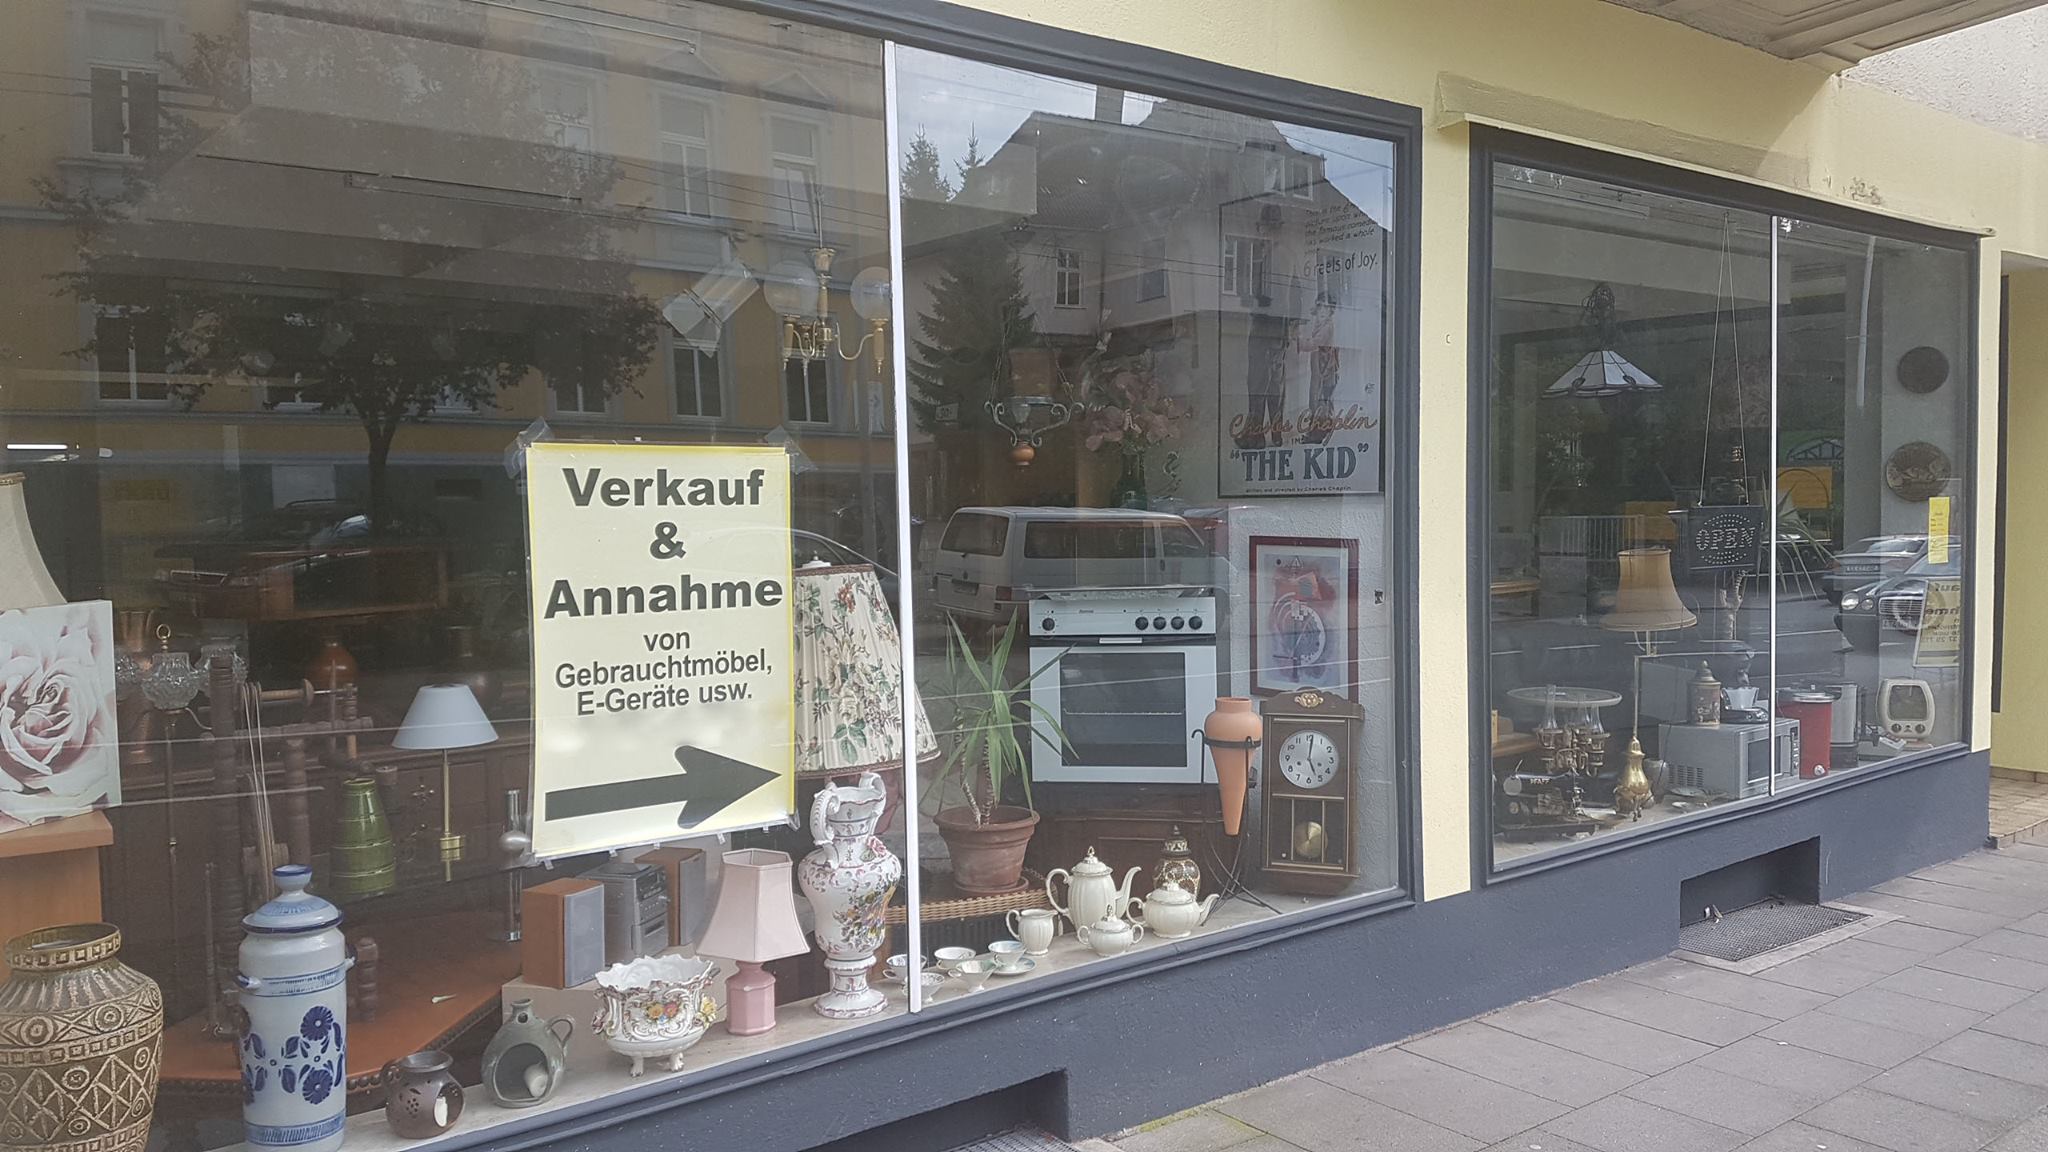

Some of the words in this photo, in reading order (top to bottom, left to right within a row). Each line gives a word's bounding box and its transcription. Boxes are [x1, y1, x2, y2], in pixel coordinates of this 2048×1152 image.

[1303, 260, 1311, 277] 6
[1314, 256, 1341, 276] reels
[1345, 252, 1356, 270] of
[1358, 251, 1378, 271] Joy.
[1229, 413, 1293, 440] Charles
[1297, 403, 1378, 446] Chaplin
[561, 467, 765, 507] Verkauf
[649, 521, 687, 560] &
[1695, 527, 1755, 551] OPEN
[543, 574, 783, 619] Annahme
[642, 630, 691, 652] von
[555, 648, 773, 689] Gebrauchtmöbel,
[576, 684, 690, 716] E-Geräte
[699, 682, 753, 704] usw.
[1285, 754, 1291, 762] 9
[1326, 745, 1332, 753] 2
[1288, 765, 1293, 773] 8
[1296, 773, 1301, 781] 7
